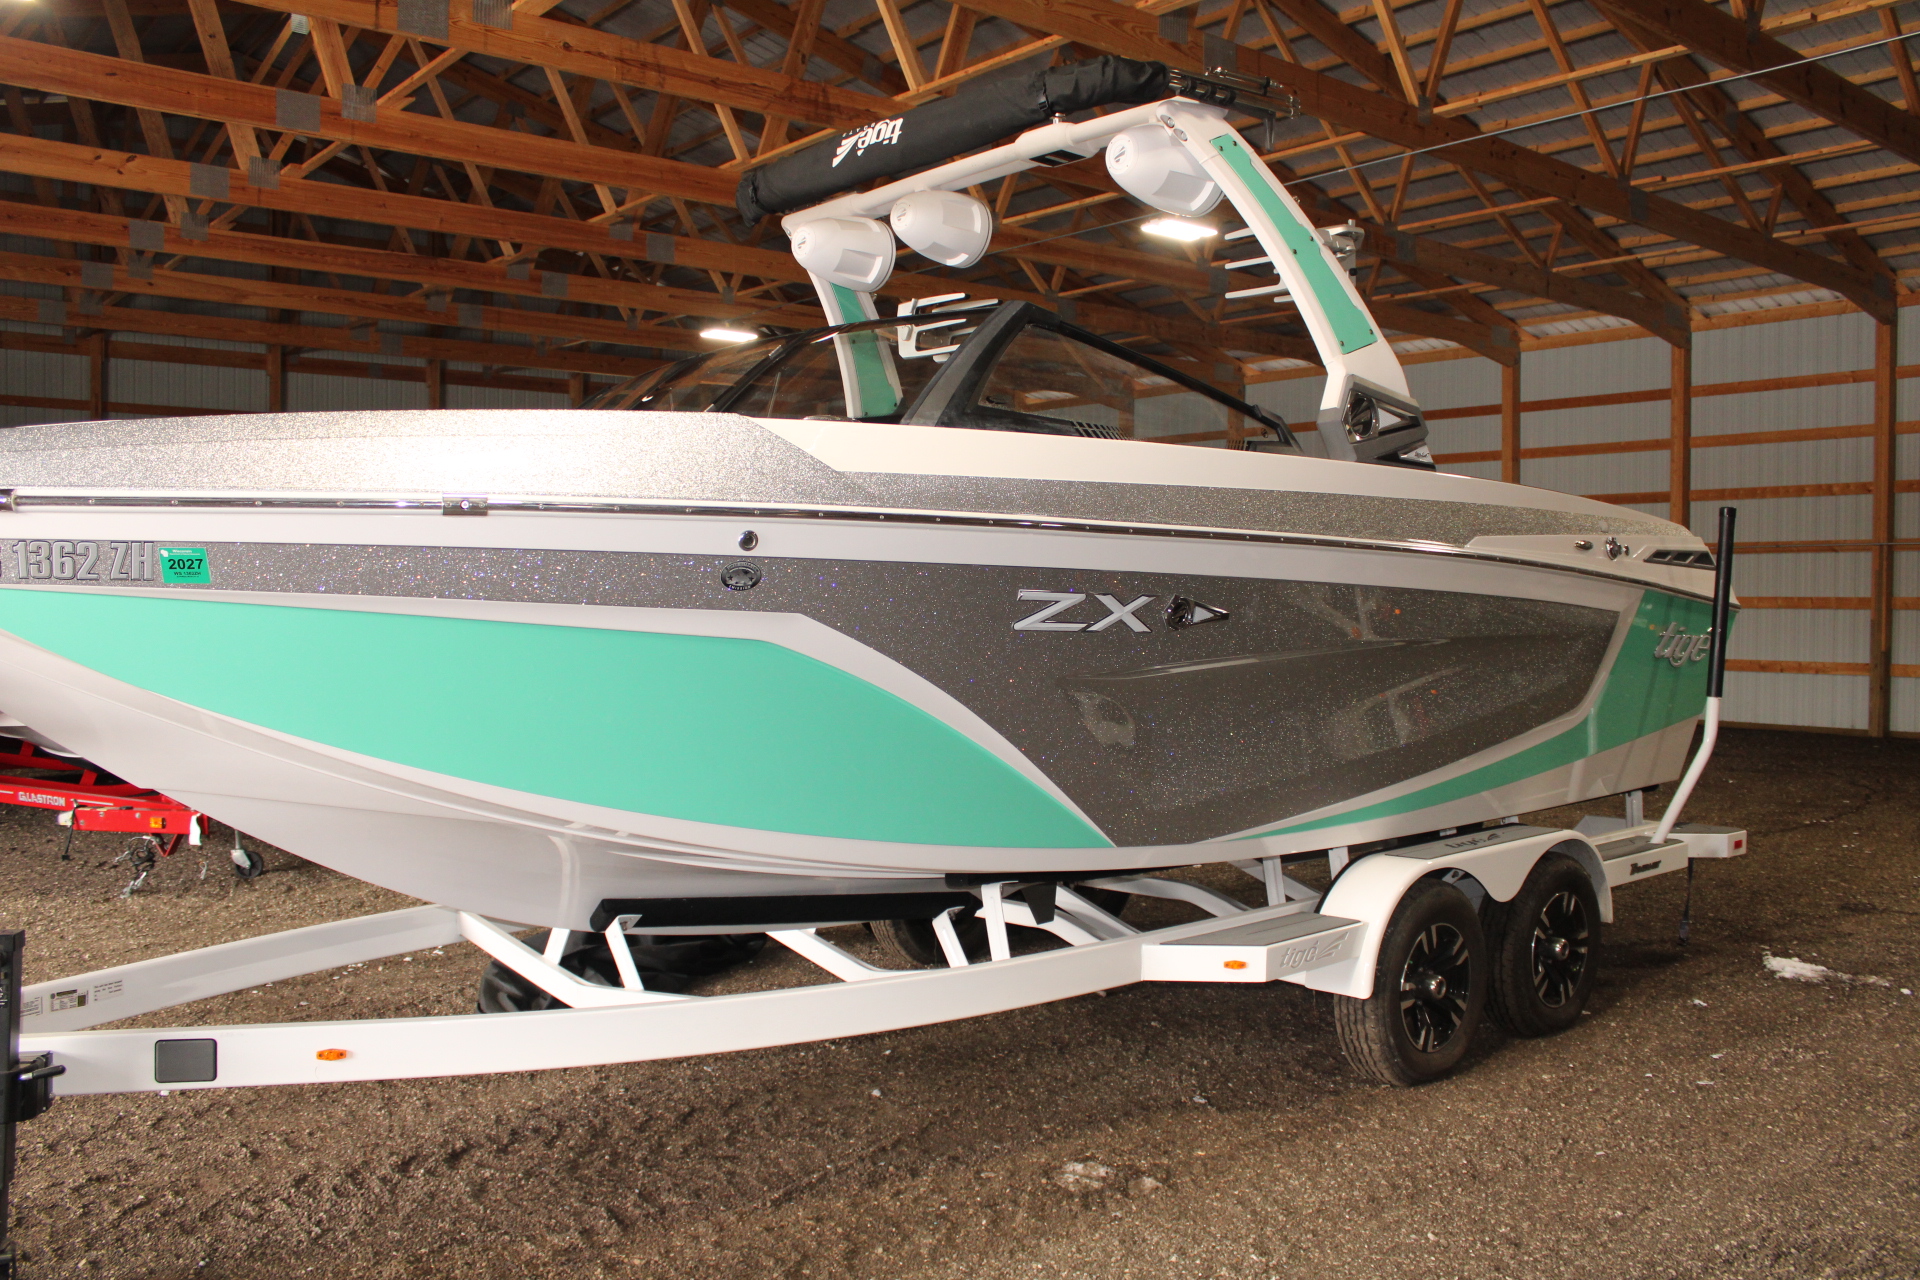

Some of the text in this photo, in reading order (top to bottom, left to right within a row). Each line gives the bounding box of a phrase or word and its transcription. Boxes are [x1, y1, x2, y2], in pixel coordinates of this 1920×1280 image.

[857, 117, 904, 156] tigé
[12, 539, 100, 581] 1362
[110, 540, 154, 582] ZH
[168, 558, 203, 570] 2027
[1012, 588, 1160, 633] ZX
[18, 791, 66, 807] GLASTRON
[1280, 940, 1319, 969] tigé
